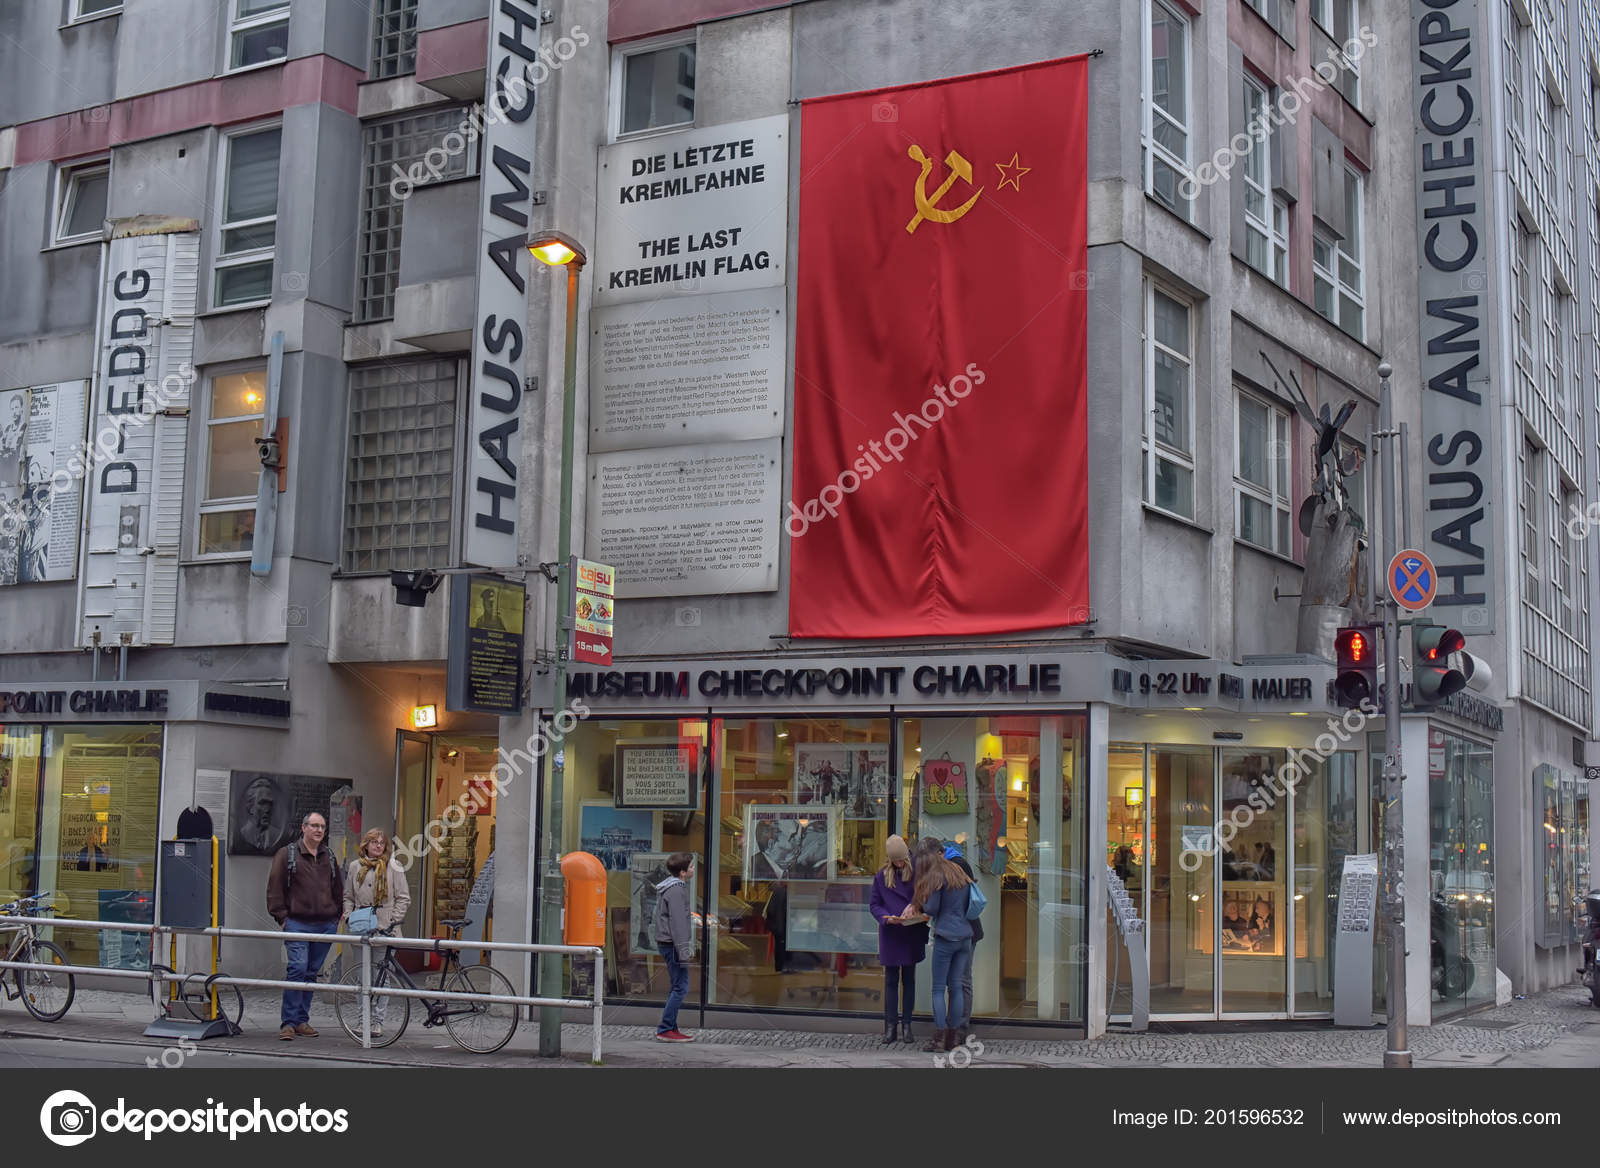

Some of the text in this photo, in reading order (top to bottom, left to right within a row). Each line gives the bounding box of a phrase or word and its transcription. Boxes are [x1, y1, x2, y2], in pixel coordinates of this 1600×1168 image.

[632, 139, 754, 176] DIE LETZTE
[620, 164, 765, 204] KREMLFAHNE
[638, 228, 742, 259] THE LAST
[476, 0, 538, 535] HAUS AM CH
[609, 251, 770, 289] KREMLIN FLAG
[1419, 0, 1486, 607] HAUS AM CHECKP
[100, 269, 151, 493] D-EDDG
[566, 664, 1061, 697] MUSEUM CHECKPOINT CHARLIE
[1140, 673, 1178, 694] 9-22
[1182, 672, 1212, 694] Uhr
[1252, 678, 1312, 700] MAUER
[70, 690, 168, 713] CHARLIE
